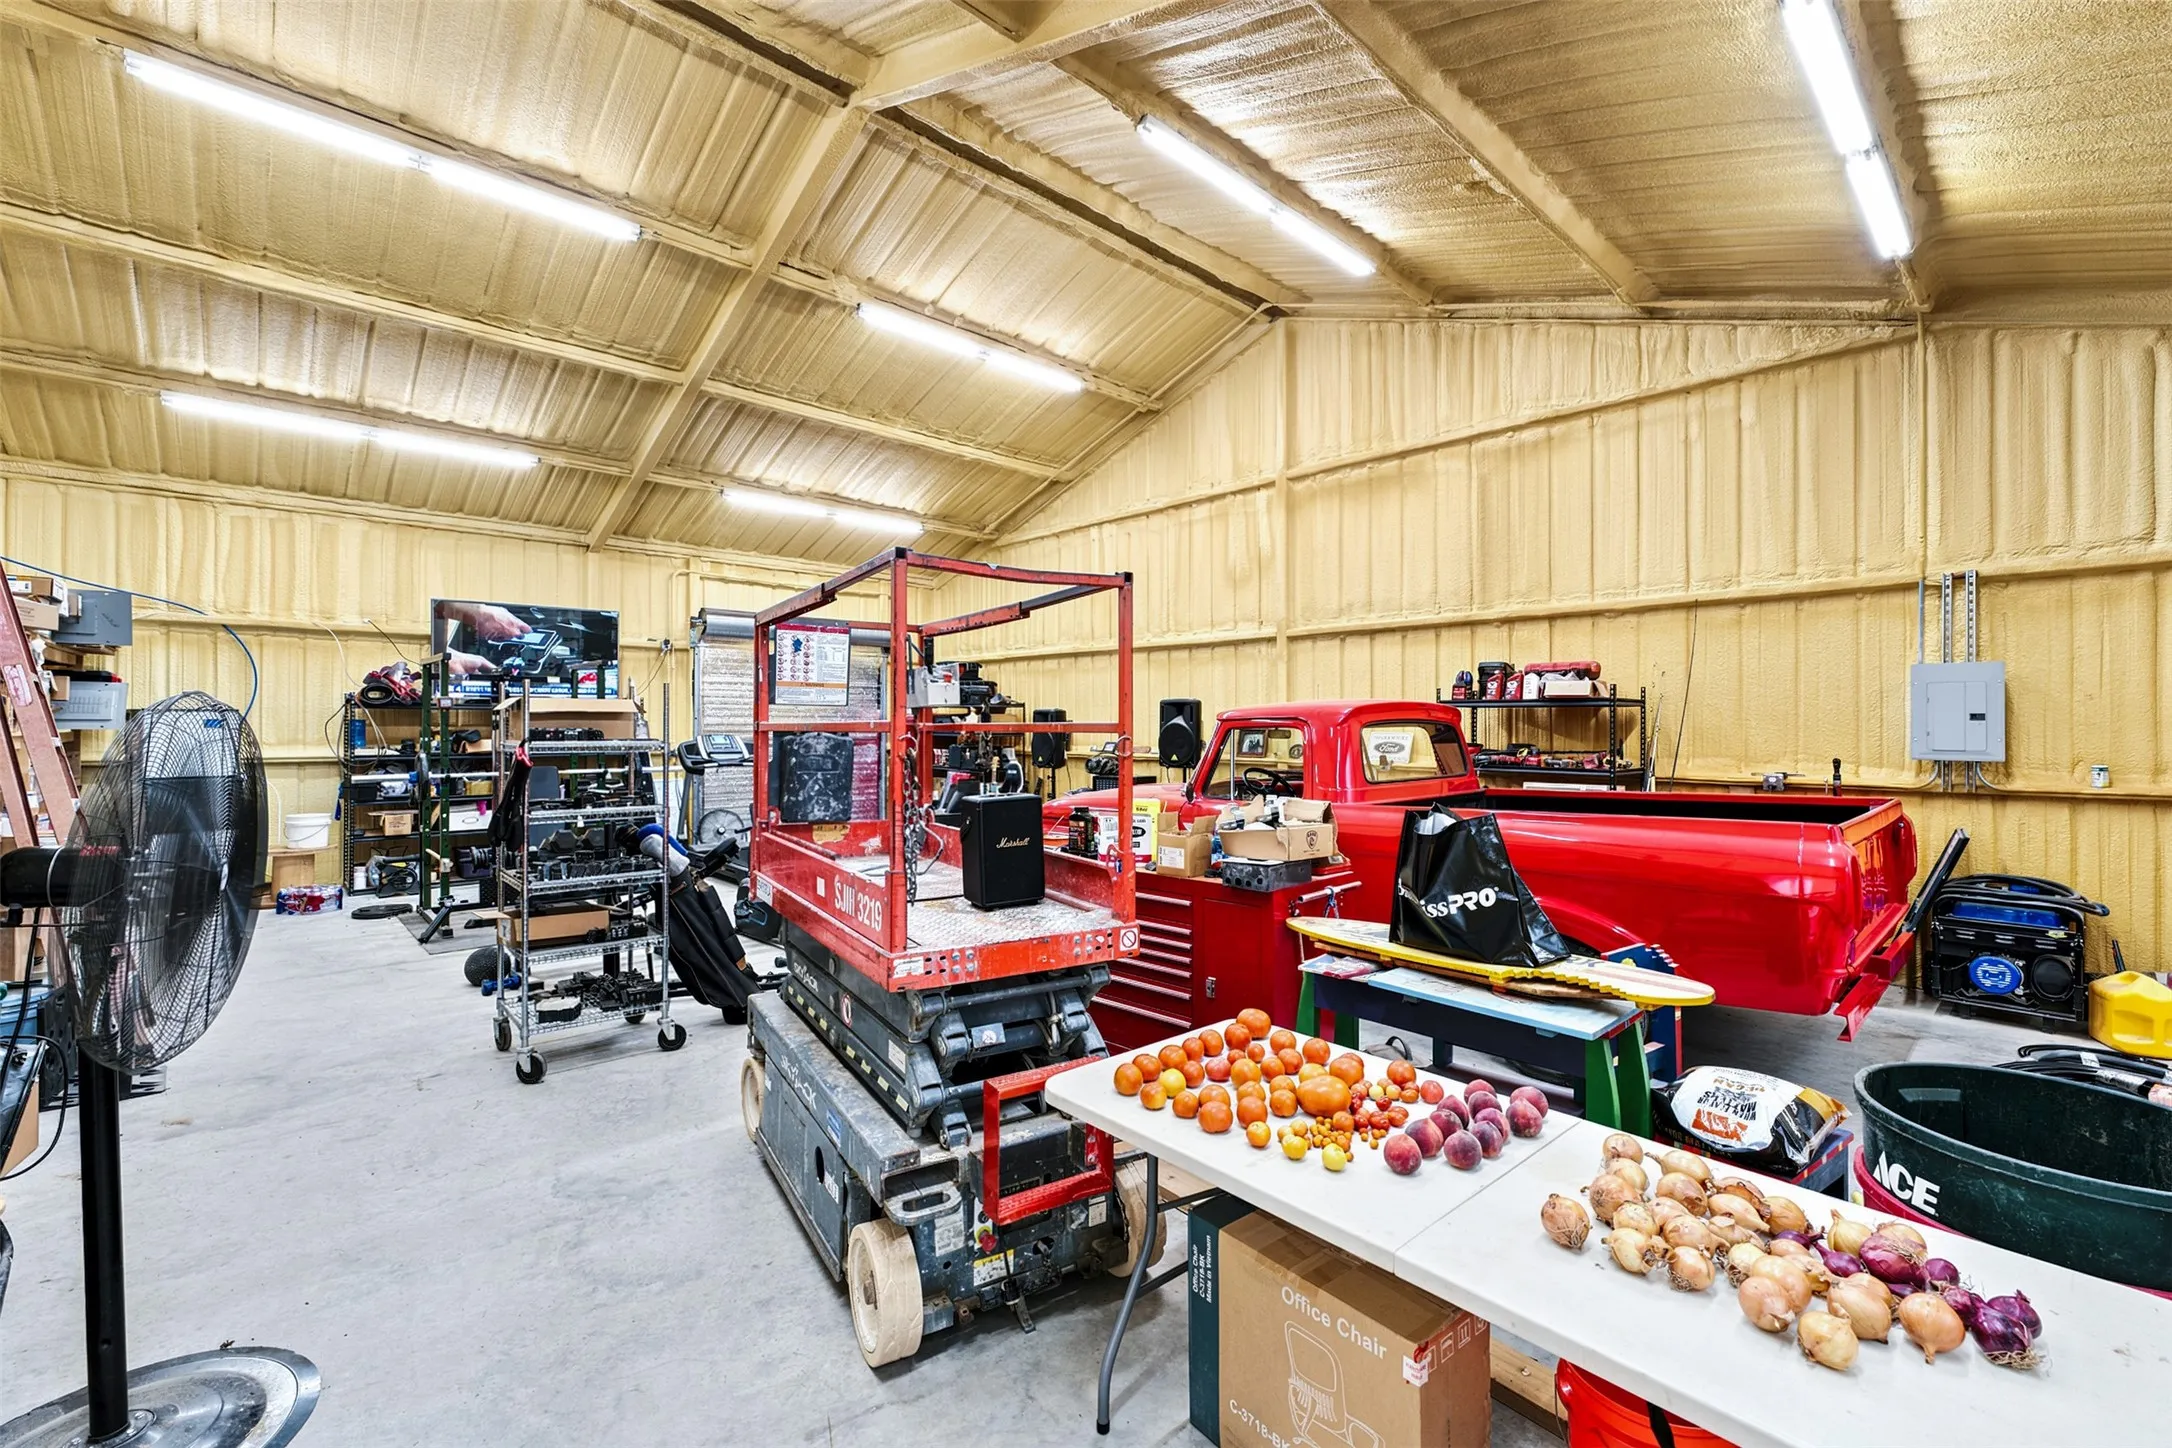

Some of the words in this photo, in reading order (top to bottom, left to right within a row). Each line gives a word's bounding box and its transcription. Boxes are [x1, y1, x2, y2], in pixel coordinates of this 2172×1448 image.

[996, 837, 1030, 848] Marshall
[857, 891, 883, 932] 3219
[1872, 1150, 1941, 1216] ACE
[1206, 1270, 1212, 1280] in
[1281, 1286, 1331, 1328] Office
[1337, 1317, 1387, 1360] Chair
[1229, 1399, 1290, 1448] C-3718-BK
